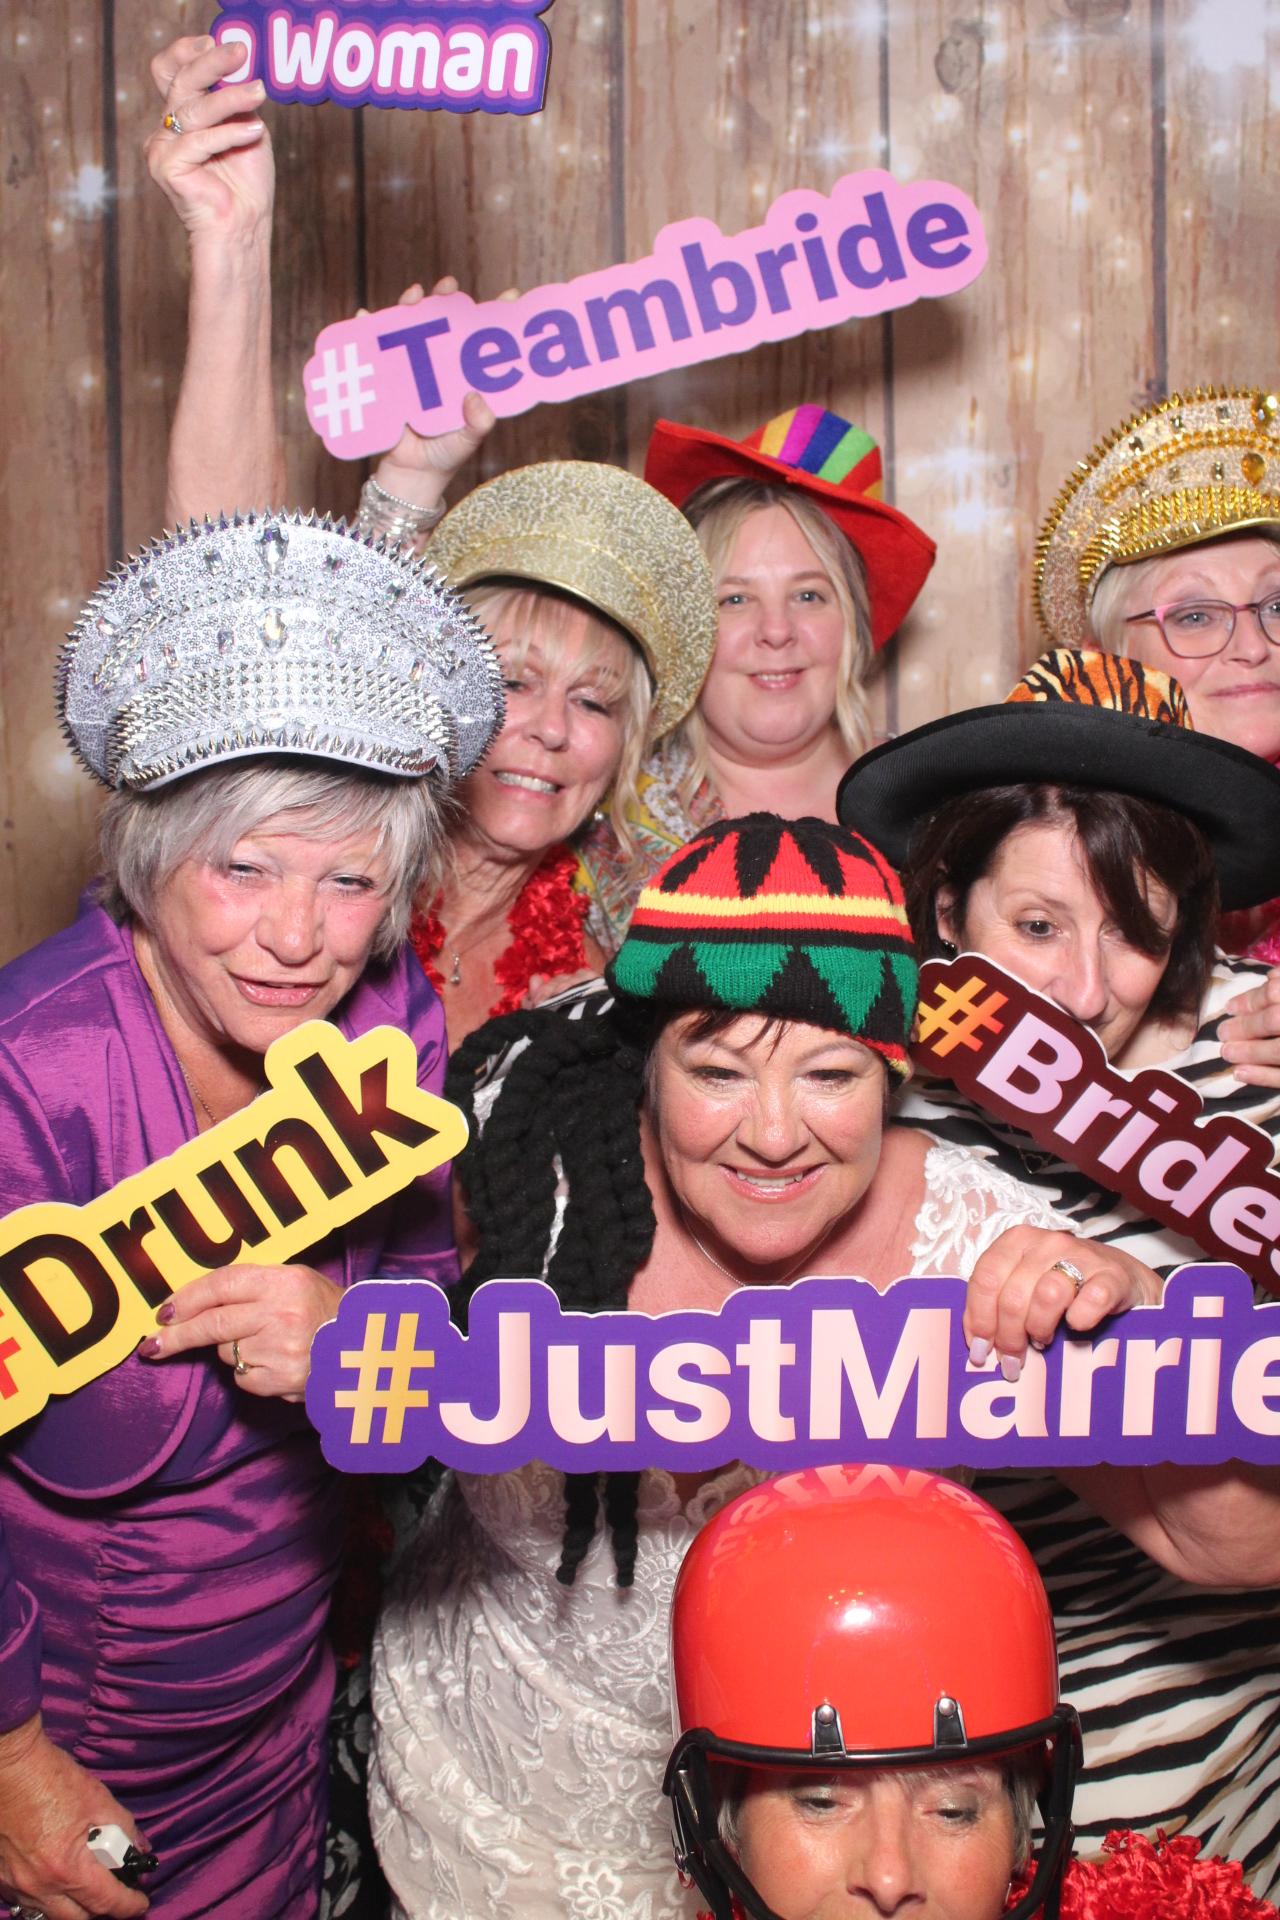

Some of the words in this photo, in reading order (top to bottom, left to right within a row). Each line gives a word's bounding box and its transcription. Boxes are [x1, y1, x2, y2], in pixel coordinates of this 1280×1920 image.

[273, 17, 534, 93] Woman
[310, 191, 971, 438] #Teambride
[0, 1052, 440, 1400] Drunk
[918, 975, 1280, 1275] #Bride
